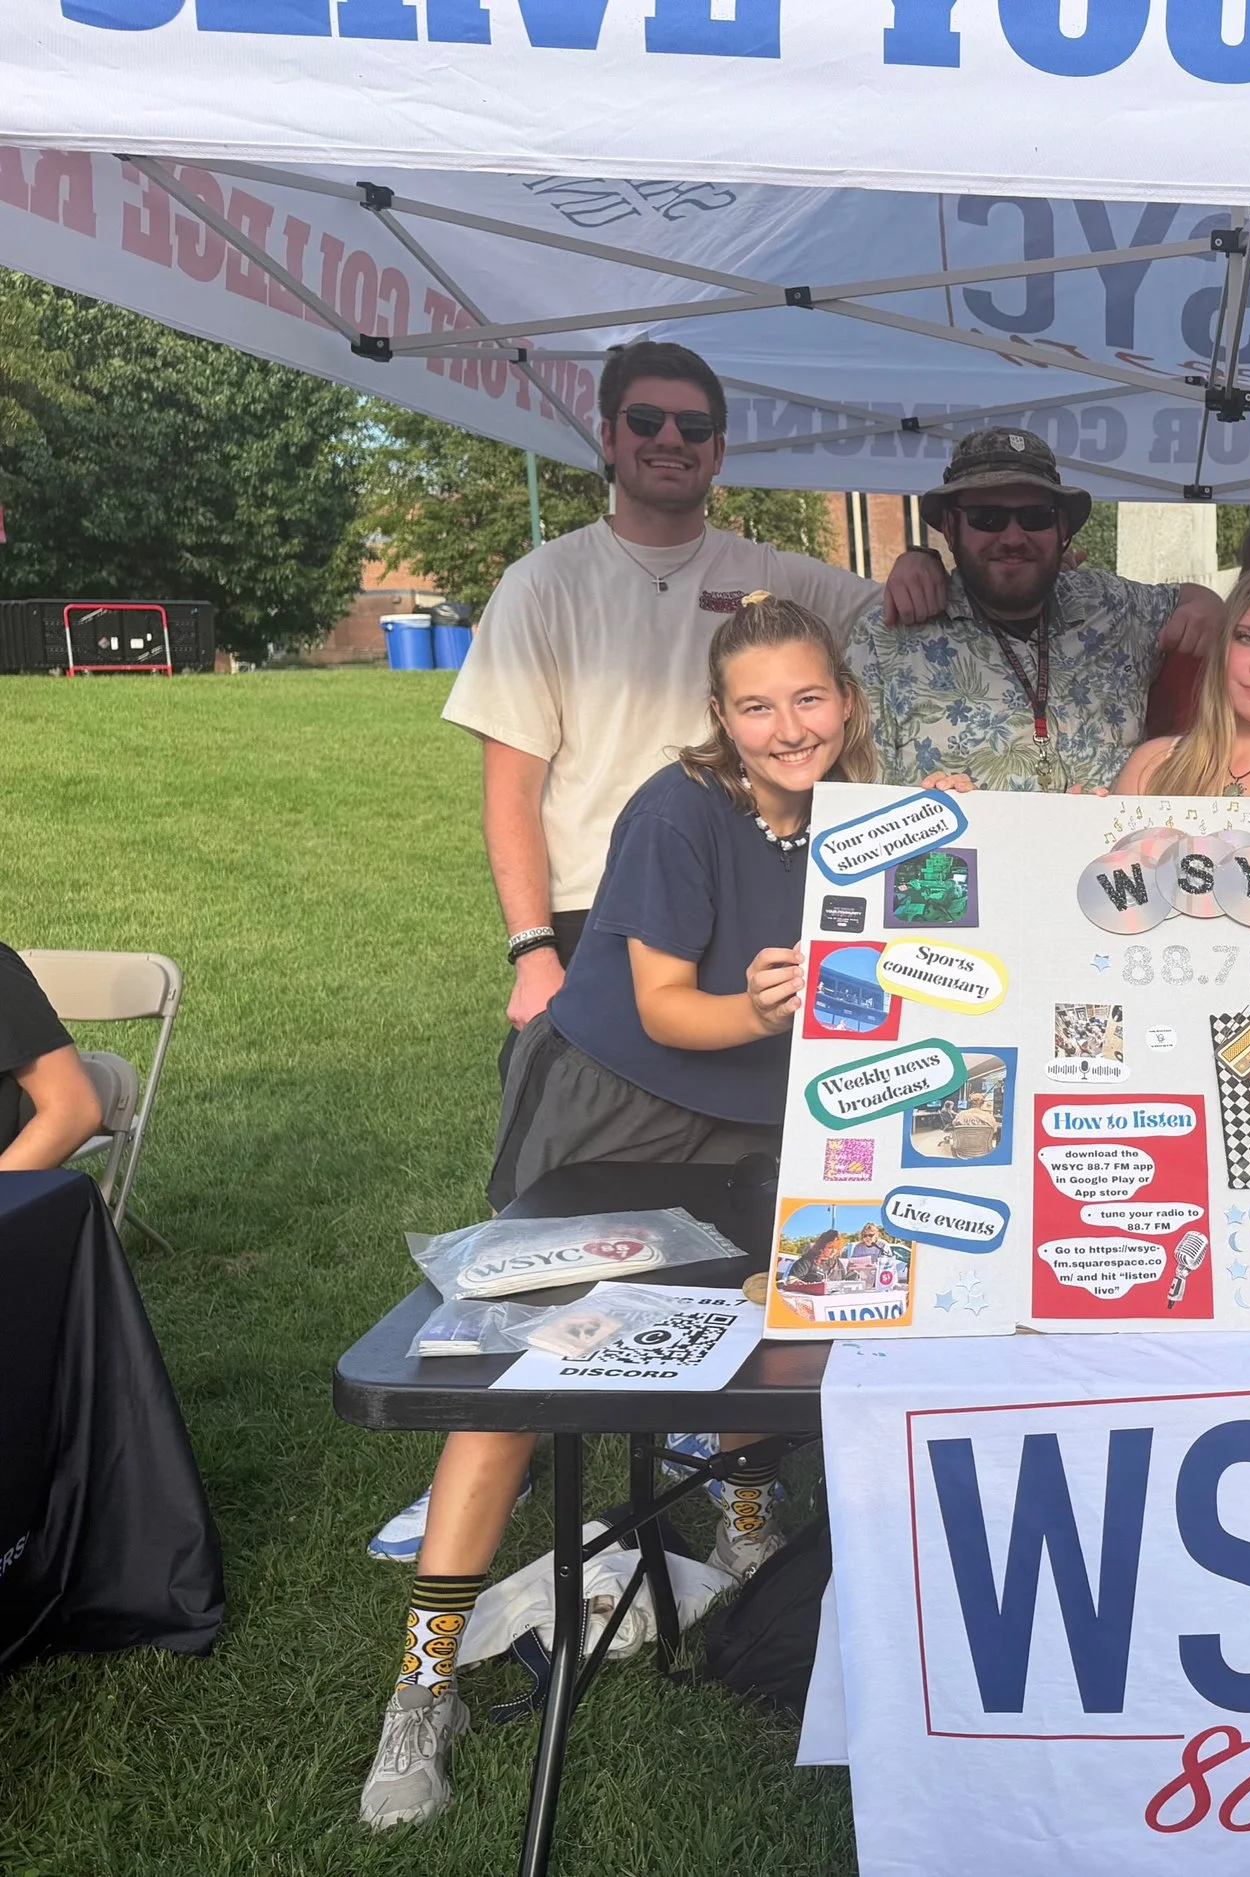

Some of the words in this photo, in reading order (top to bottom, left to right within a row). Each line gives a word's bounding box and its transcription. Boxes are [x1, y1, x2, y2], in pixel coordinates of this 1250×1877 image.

[823, 832, 864, 855] Your
[868, 821, 900, 839] own
[902, 803, 943, 827] radio
[837, 819, 949, 872] show/podcast!
[916, 946, 975, 973] Sports
[1122, 945, 1240, 986] 88.7
[883, 959, 989, 999] commentary
[821, 1067, 891, 1095] Weekly
[894, 1054, 940, 1076] news
[837, 1078, 930, 1114] broadcast
[1054, 1112, 1102, 1130] How
[1107, 1115, 1128, 1130] to
[1133, 1110, 1192, 1129] listen
[1065, 1150, 1118, 1159] download
[1121, 1150, 1139, 1159] the
[1051, 1163, 1084, 1171] WSYC
[1087, 1163, 1110, 1171] 88.7
[1114, 1163, 1130, 1171] FM
[1133, 1164, 1153, 1172] app
[1056, 1176, 1066, 1184] in
[1070, 1176, 1108, 1185] Google
[1112, 1175, 1135, 1185] Play
[1075, 1189, 1096, 1198] App
[1099, 1189, 1128, 1197] store
[891, 1200, 930, 1223] Live
[934, 1215, 995, 1236] events
[1101, 1210, 1126, 1218] tune
[1129, 1211, 1153, 1220] your
[1156, 1209, 1184, 1217] radio
[1188, 1209, 1199, 1217] to
[1128, 1223, 1150, 1231] 88.7
[1055, 1246, 1071, 1255] Go
[1074, 1246, 1087, 1254] to
[473, 1247, 584, 1278] WSYC
[1054, 1258, 1162, 1268] fm.squarespace.co
[1060, 1272, 1073, 1281] m/
[1076, 1273, 1097, 1281] and
[1101, 1272, 1116, 1281] hit
[559, 1367, 679, 1379] DISCORD
